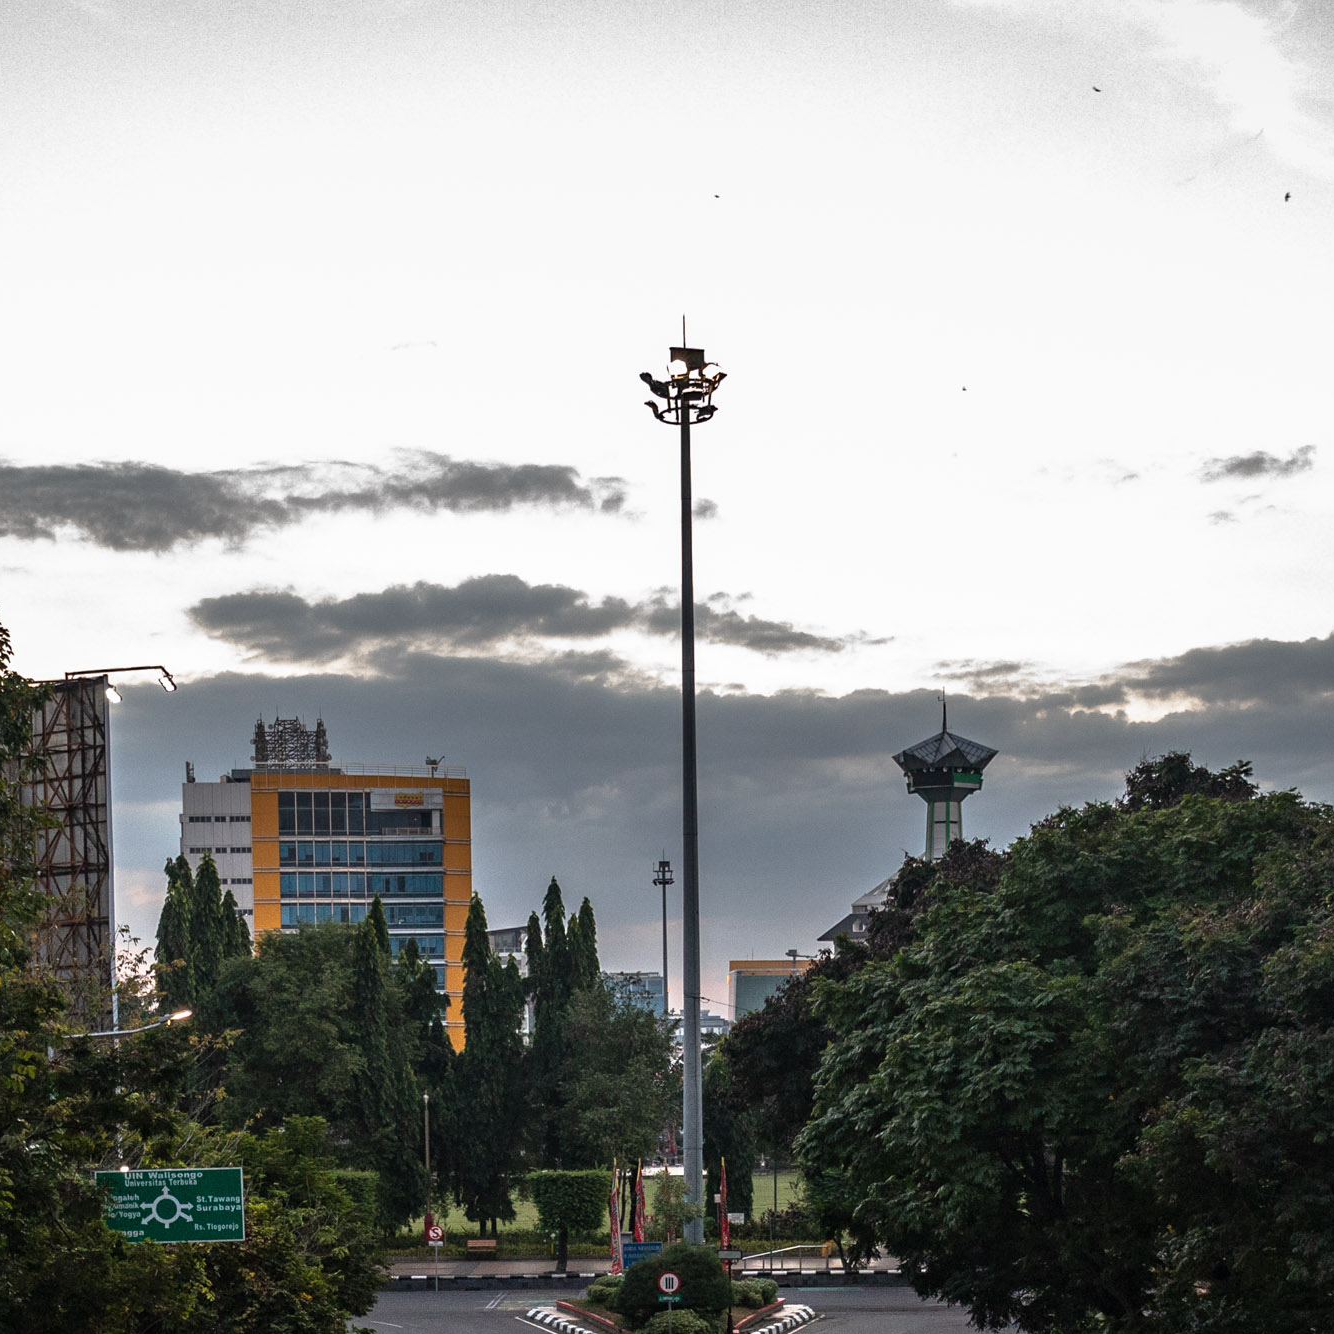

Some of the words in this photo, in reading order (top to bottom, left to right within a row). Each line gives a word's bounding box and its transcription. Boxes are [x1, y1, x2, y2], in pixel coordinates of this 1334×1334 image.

[124, 1172, 143, 1180] UIN
[148, 1171, 204, 1179] Walisongo
[124, 1179, 166, 1187] Universitas
[168, 1178, 198, 1186] Terbuka
[196, 1204, 242, 1212] Surabaya
